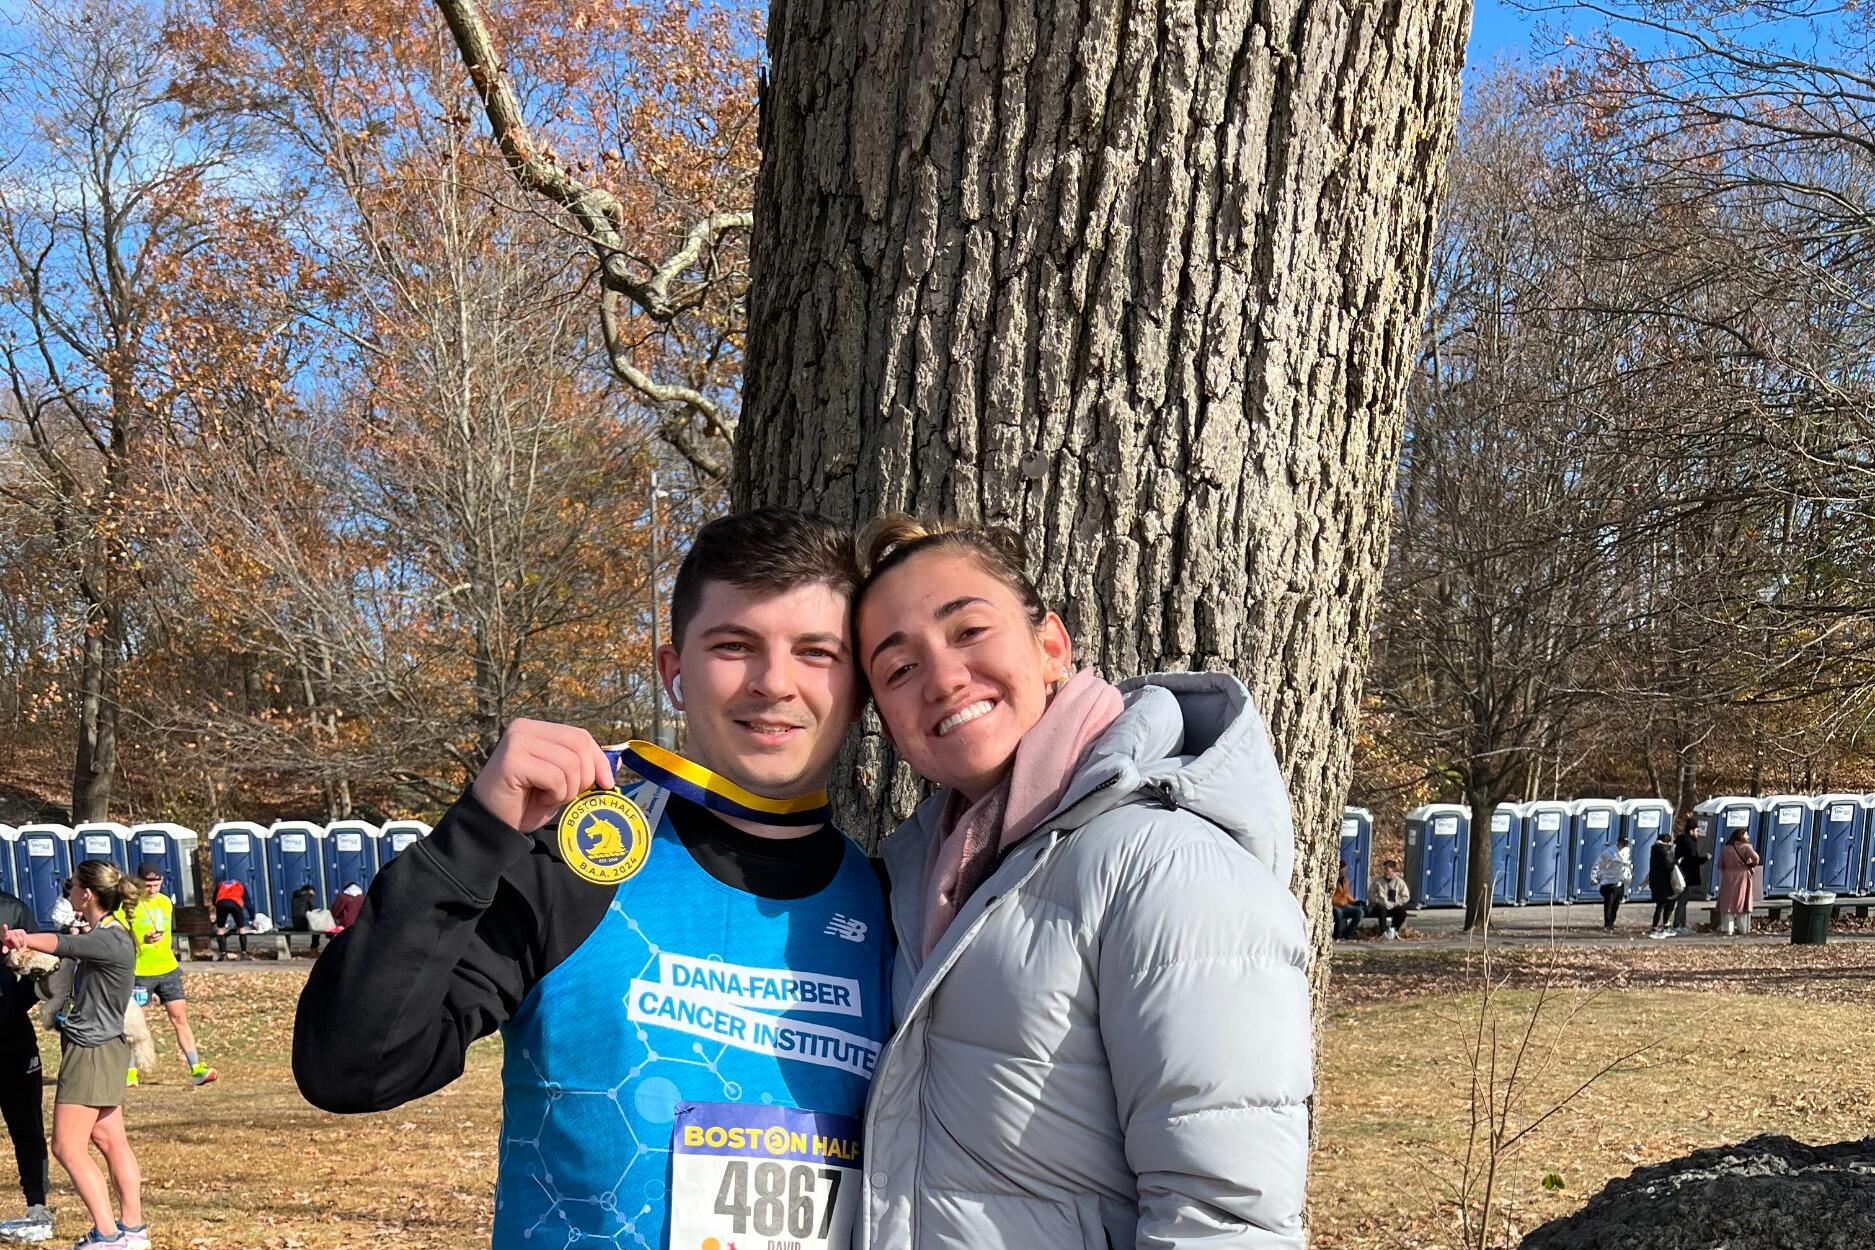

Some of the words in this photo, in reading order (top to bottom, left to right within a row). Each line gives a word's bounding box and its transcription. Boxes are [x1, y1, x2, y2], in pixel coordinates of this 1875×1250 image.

[567, 798, 606, 827] BOSTON
[610, 798, 638, 821] HALF
[579, 861, 610, 878] B.A.A.
[613, 856, 638, 877] 2024
[672, 963, 852, 1007] DANA-FARBER
[638, 991, 747, 1041] CANCER
[753, 1022, 877, 1073] INSTITUTE
[684, 1125, 807, 1156] BOSTON
[812, 1134, 859, 1161] HALF
[714, 1160, 842, 1240] 4867
